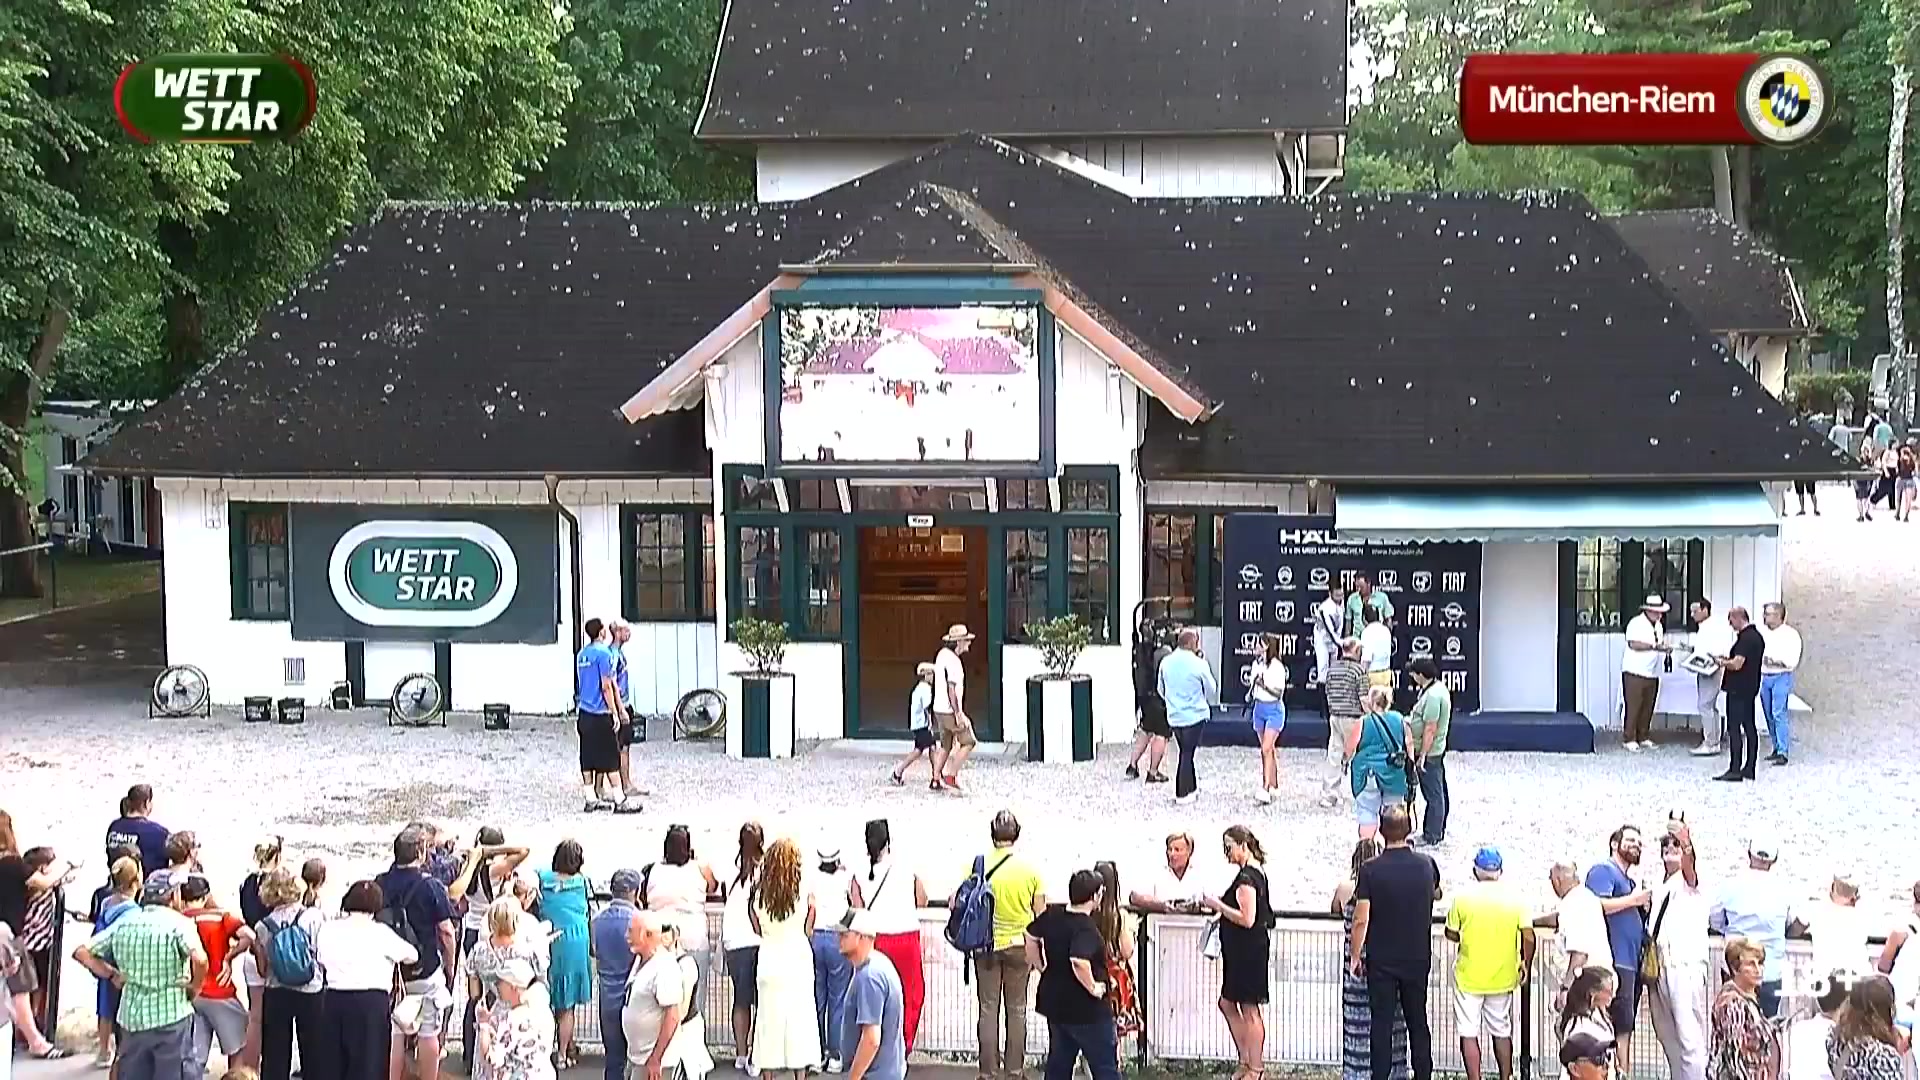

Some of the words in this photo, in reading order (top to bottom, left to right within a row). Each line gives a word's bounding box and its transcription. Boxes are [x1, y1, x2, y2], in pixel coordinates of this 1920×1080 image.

[373, 547, 461, 574] WETT
[396, 575, 476, 601] STAR
[1442, 571, 1467, 593] FIAT
[1239, 600, 1263, 622] FIAT
[1407, 604, 1434, 627] FIAT
[1276, 633, 1298, 656] IAT
[1441, 670, 1468, 692] FIAT
